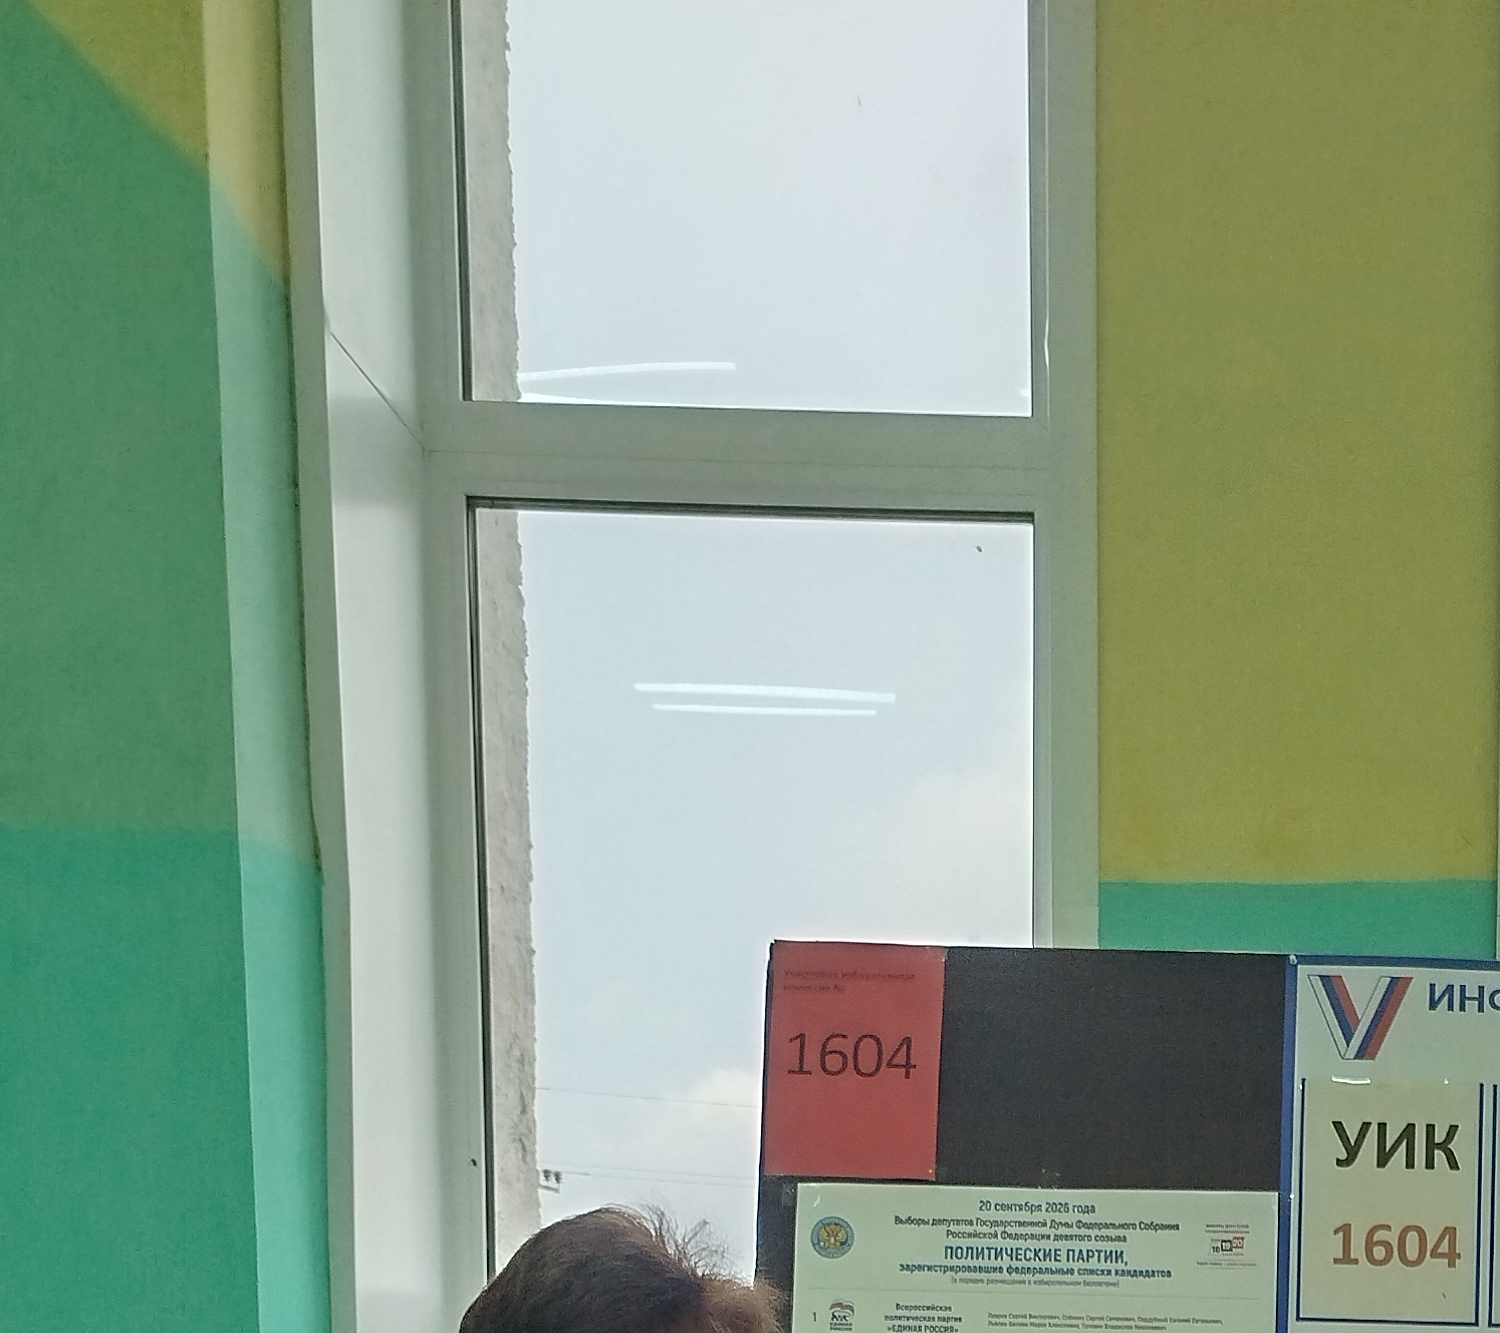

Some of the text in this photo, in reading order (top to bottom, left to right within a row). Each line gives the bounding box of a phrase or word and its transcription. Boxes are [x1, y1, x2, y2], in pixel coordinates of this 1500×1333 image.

[787, 1032, 917, 1079] 1604
[1331, 1121, 1461, 1171] УИК
[978, 1199, 1096, 1215] 20 сентября 2026 года
[893, 1215, 1180, 1232] Выборы депутатов Государственной Думы Федерального Собрания
[945, 1228, 1128, 1243] Российской Федерации девятого созыва
[944, 1245, 1128, 1264] ПОЛИТИЧЕСКИЕ ПАРТИИ,
[1332, 1223, 1462, 1268] 1604
[898, 1263, 1172, 1279] зарегистрировавшие федеральные списки кандидатов
